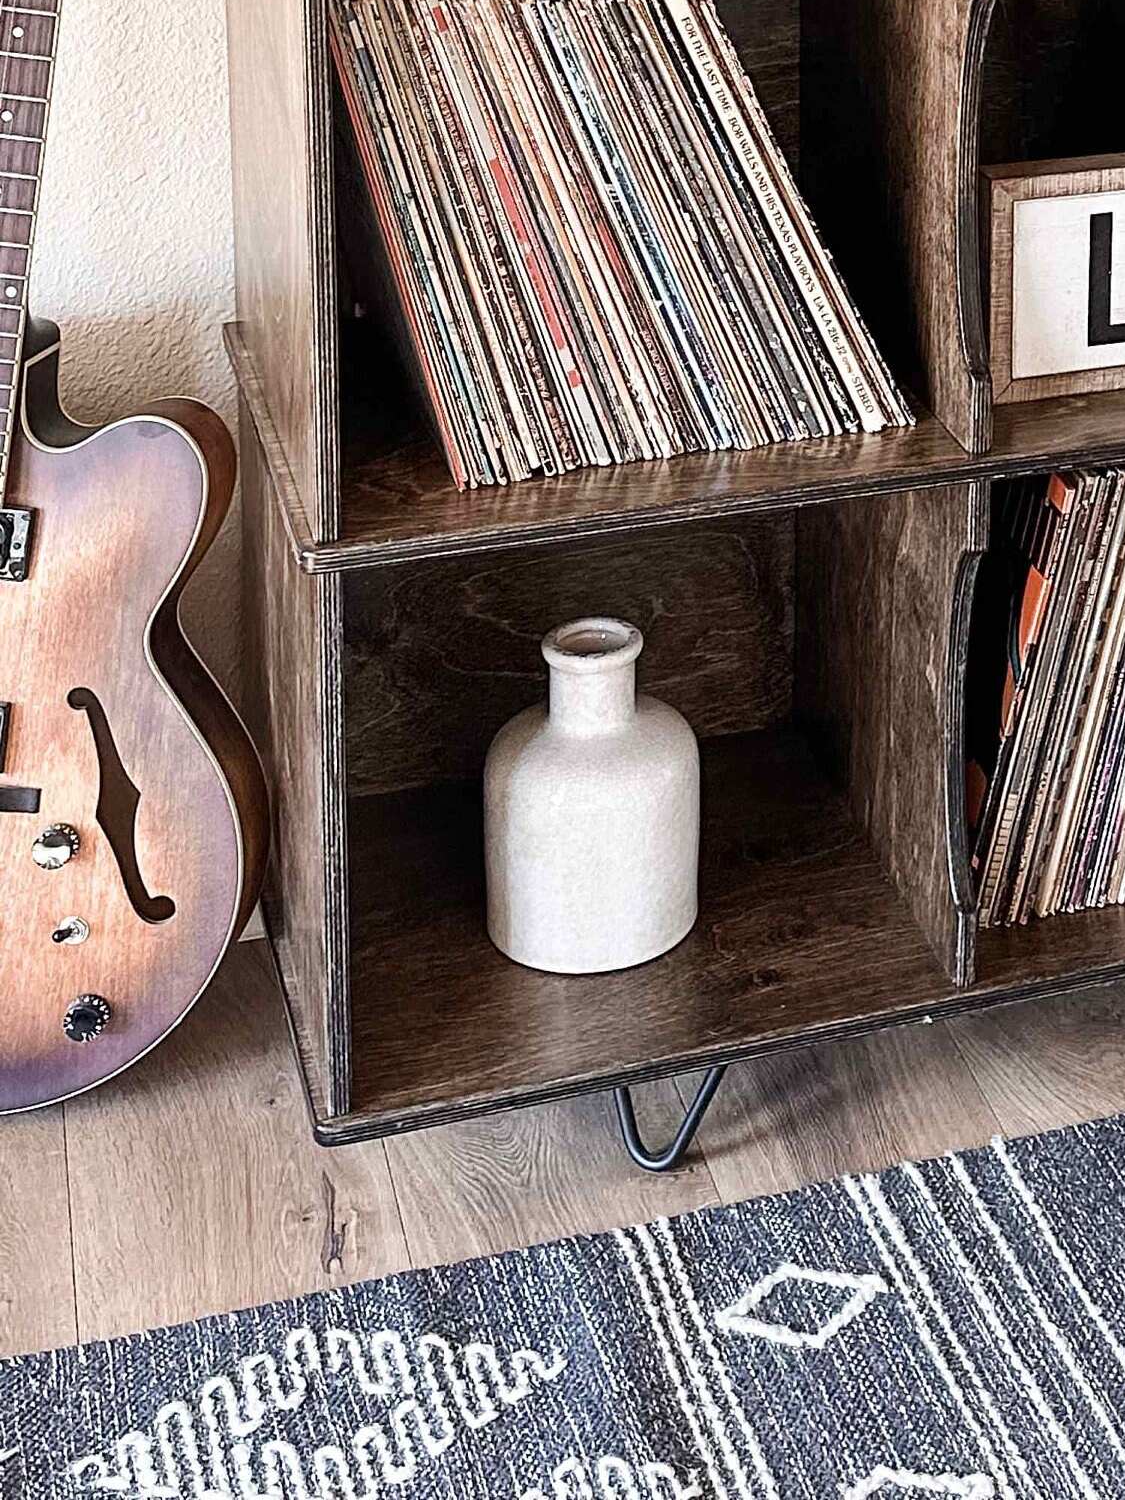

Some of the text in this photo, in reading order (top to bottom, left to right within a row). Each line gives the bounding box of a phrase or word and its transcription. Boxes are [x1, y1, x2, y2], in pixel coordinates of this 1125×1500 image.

[681, 16, 697, 39] FOR
[692, 35, 708, 62] THE
[702, 61, 721, 87] LAST
[715, 85, 733, 114] TIME
[728, 116, 745, 140] BOB
[739, 138, 760, 171] WILLS
[753, 171, 769, 193] AND
[763, 192, 777, 211] HIS
[772, 210, 793, 243] TEXAS
[788, 243, 815, 293] PLAYBOYS
[851, 376, 875, 414] STEREO
